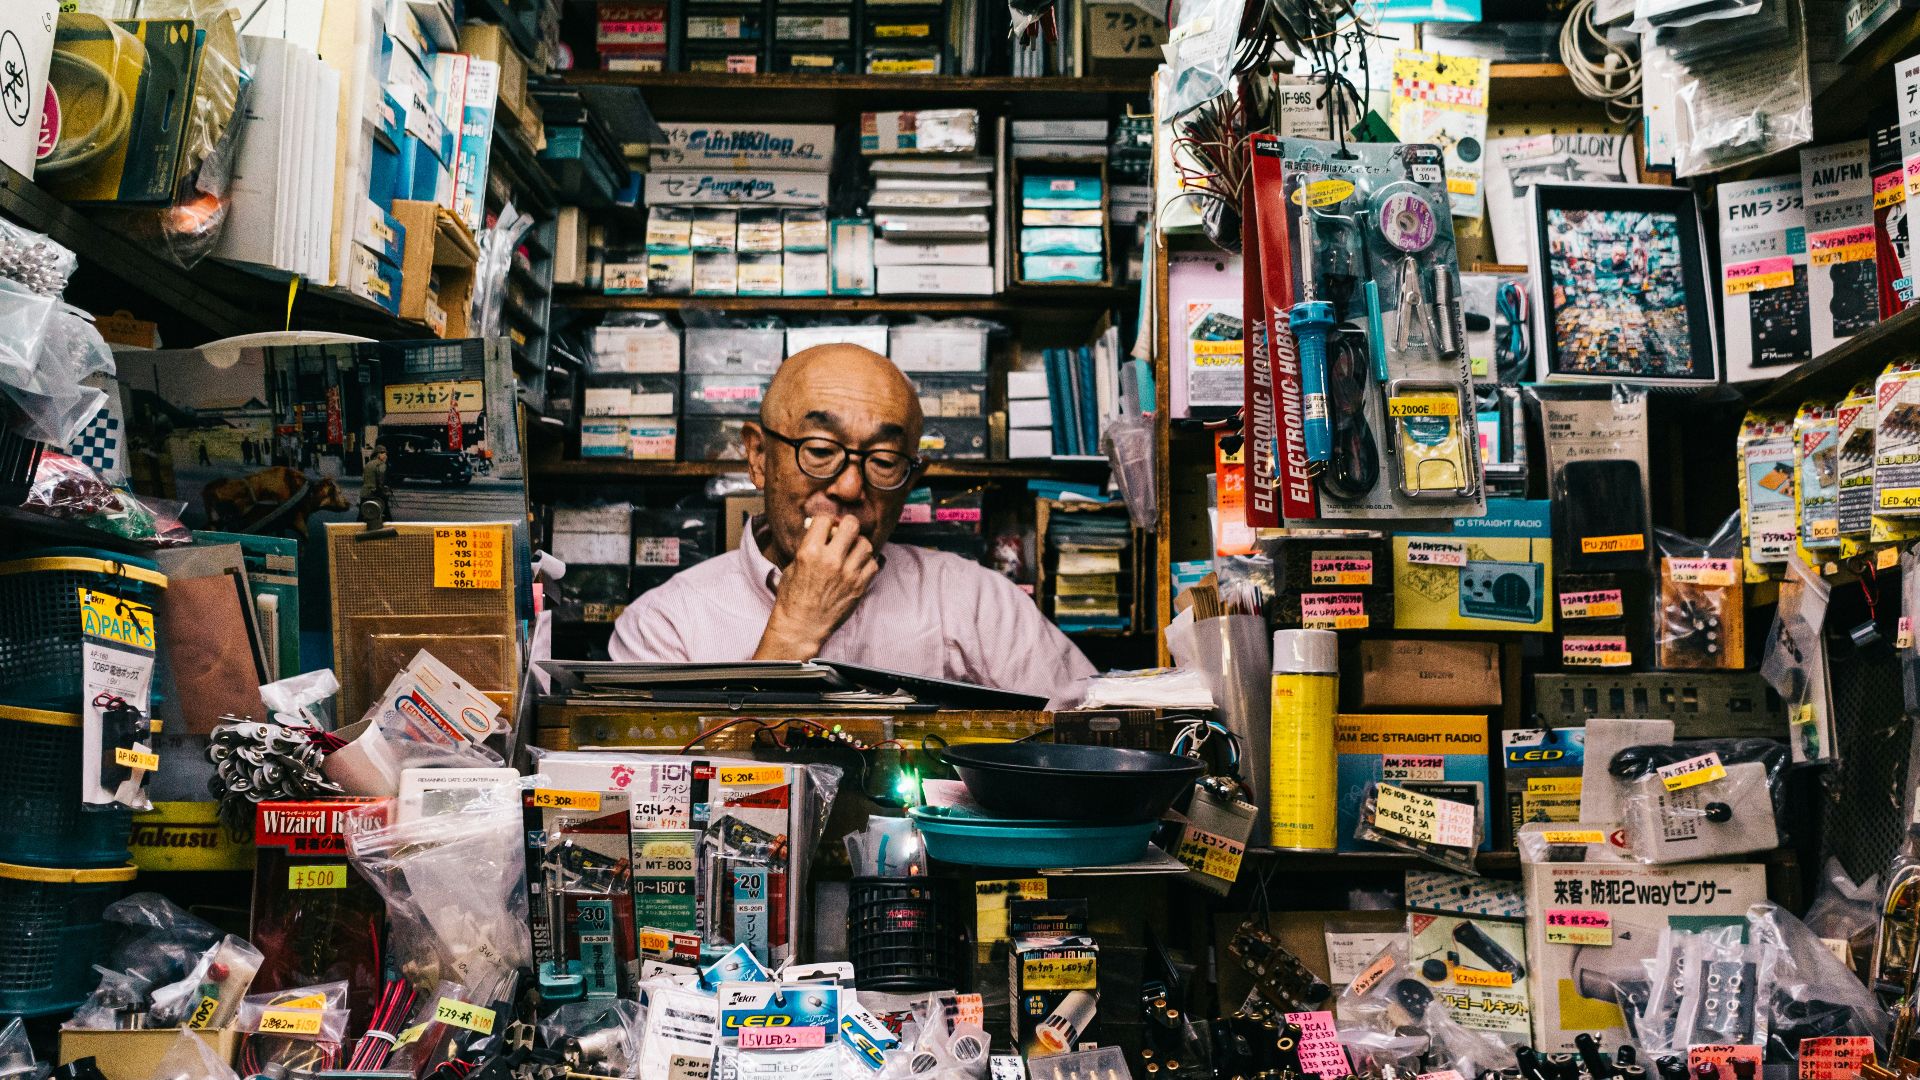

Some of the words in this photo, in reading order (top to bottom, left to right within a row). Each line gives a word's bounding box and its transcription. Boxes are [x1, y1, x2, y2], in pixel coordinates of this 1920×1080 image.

[1282, 92, 1311, 105] IF-96S
[1811, 163, 1863, 187] AM/FM
[1728, 196, 1804, 220] FMラジオ
[1274, 306, 1298, 376] HOBBY
[1252, 318, 1272, 388] HOBBY
[392, 391, 475, 405] ラジオセンター
[1281, 379, 1311, 503] ELECTRONIC
[1253, 392, 1274, 513] ELECTRONIC
[1467, 520, 1512, 528] STRAIGHT
[1513, 520, 1542, 528] RADIO
[1338, 733, 1357, 743] AM
[1382, 733, 1442, 743] STRAIGHT
[1445, 733, 1482, 743] RADIO
[1509, 749, 1564, 761] LED
[721, 770, 754, 783] KS-20R
[536, 794, 572, 806] KS-30R
[263, 810, 327, 834] Wizard
[1192, 830, 1228, 849] リモコン
[645, 860, 692, 871] MT-803
[295, 870, 334, 888] ¥500
[740, 875, 761, 890] 20
[1554, 879, 1732, 906] 来客・防犯2wayセンサー
[583, 907, 605, 922] 30
[738, 904, 763, 912] KS-20R
[1043, 951, 1061, 960] Color
[1064, 951, 1075, 959] LED
[1437, 993, 1529, 1016] ルゴールキット
[726, 1015, 792, 1028] LED
[765, 1034, 783, 1046] LED
